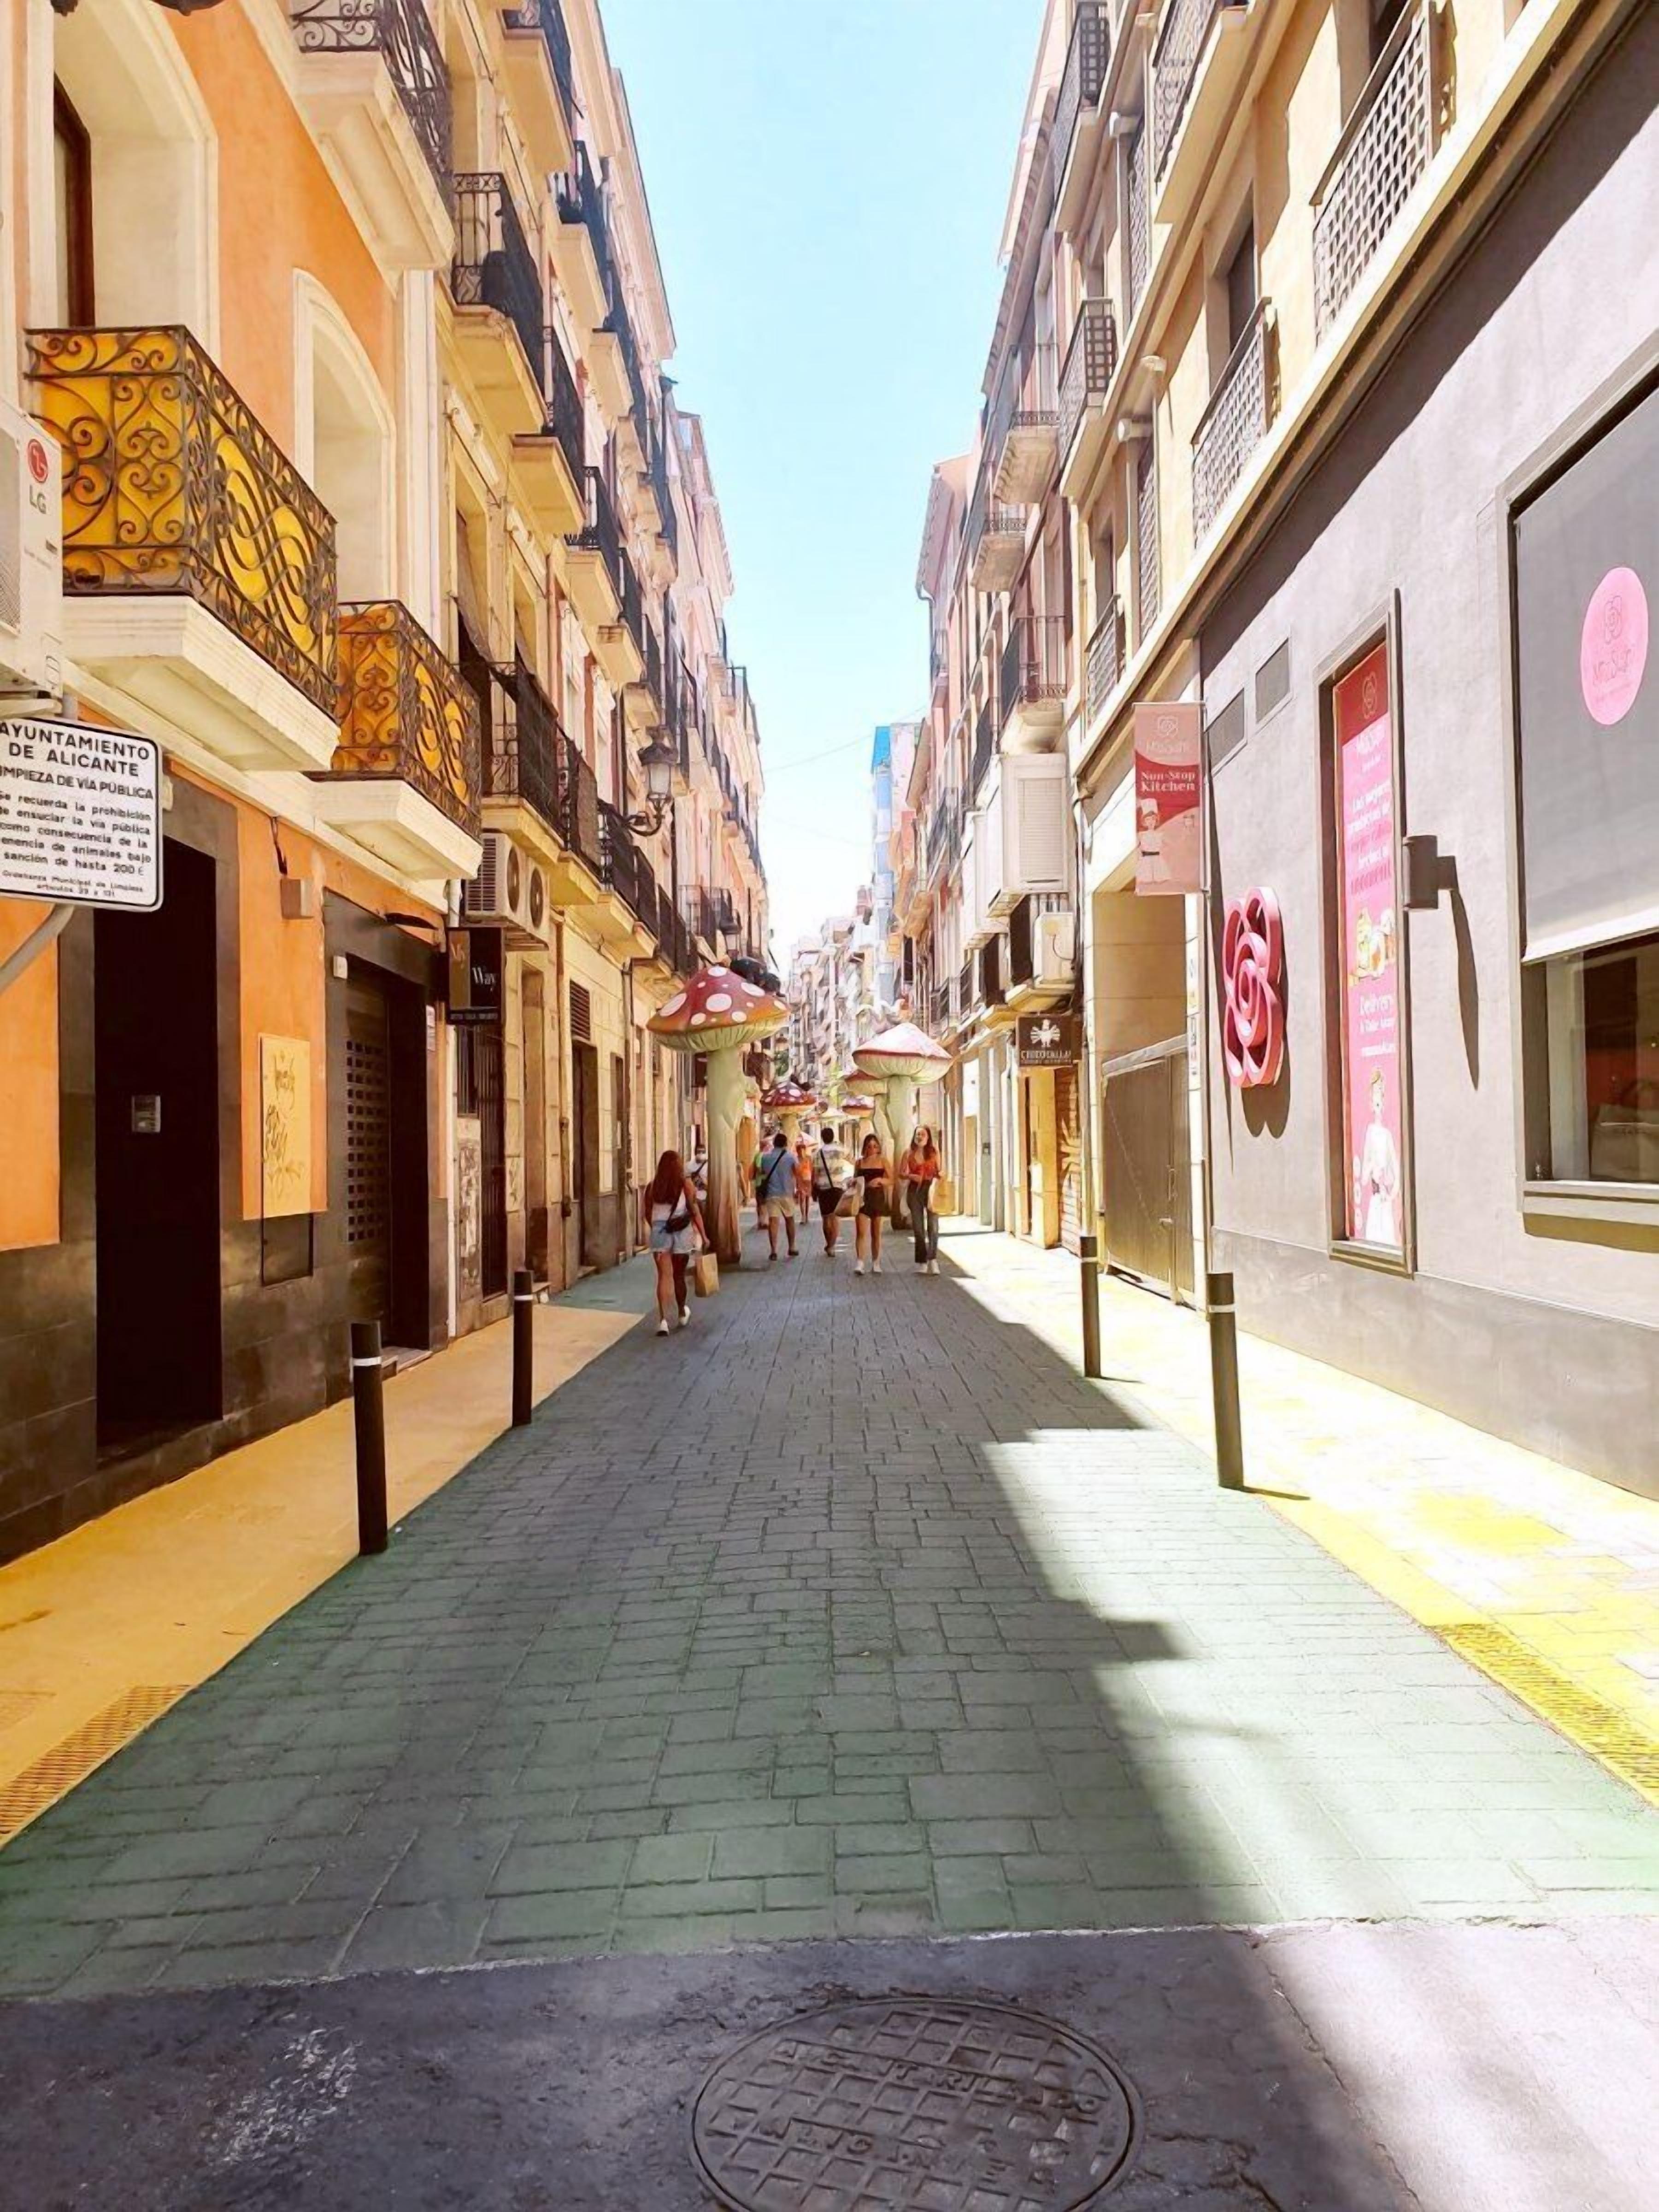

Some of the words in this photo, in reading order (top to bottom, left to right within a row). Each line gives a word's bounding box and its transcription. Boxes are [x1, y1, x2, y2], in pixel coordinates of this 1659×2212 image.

[29, 484, 47, 514] LG
[0, 722, 149, 760] AYUNTAMIENTO
[9, 742, 34, 759] DE
[47, 749, 139, 777] ALICANTE
[0, 765, 54, 783] IMPIEZA
[57, 775, 75, 788] DE
[1141, 781, 1195, 792] Kitchen
[18, 795, 68, 809] recuerda
[76, 801, 85, 811] la
[17, 810, 65, 823] ensuciar
[72, 817, 83, 825] la
[37, 827, 111, 843] consecuencia
[119, 837, 131, 846] de
[139, 838, 148, 848] la
[52, 842, 65, 852] de
[72, 845, 121, 859] animales
[128, 852, 152, 864] bajo
[55, 857, 68, 867] de
[76, 859, 106, 871] hasta
[114, 863, 135, 874] 200
